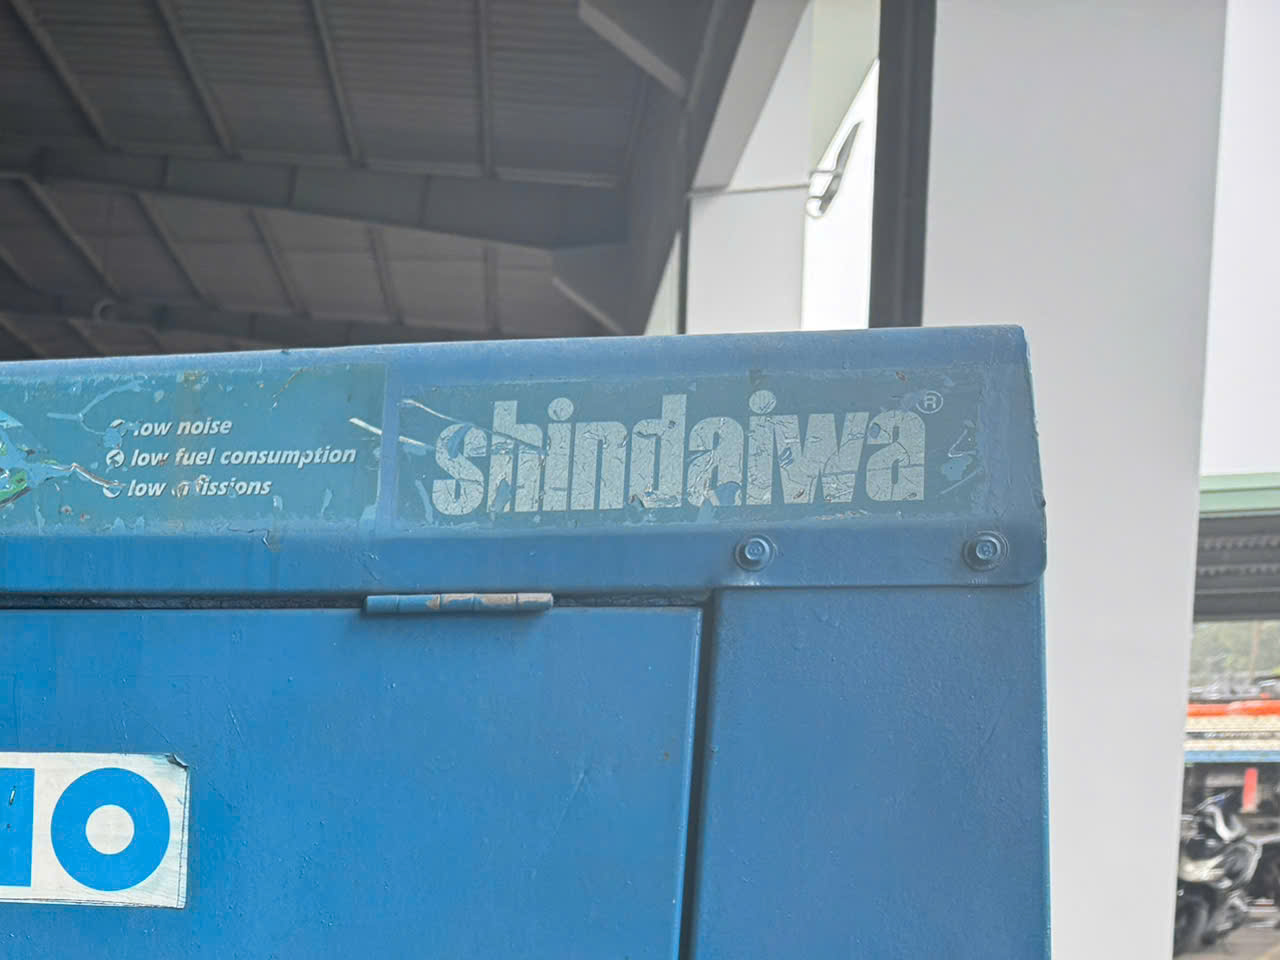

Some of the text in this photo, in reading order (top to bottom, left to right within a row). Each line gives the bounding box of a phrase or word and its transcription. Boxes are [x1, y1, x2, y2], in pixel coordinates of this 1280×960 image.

[176, 416, 233, 436] noise
[130, 445, 357, 469] low fuel consumption
[127, 479, 167, 497] low
